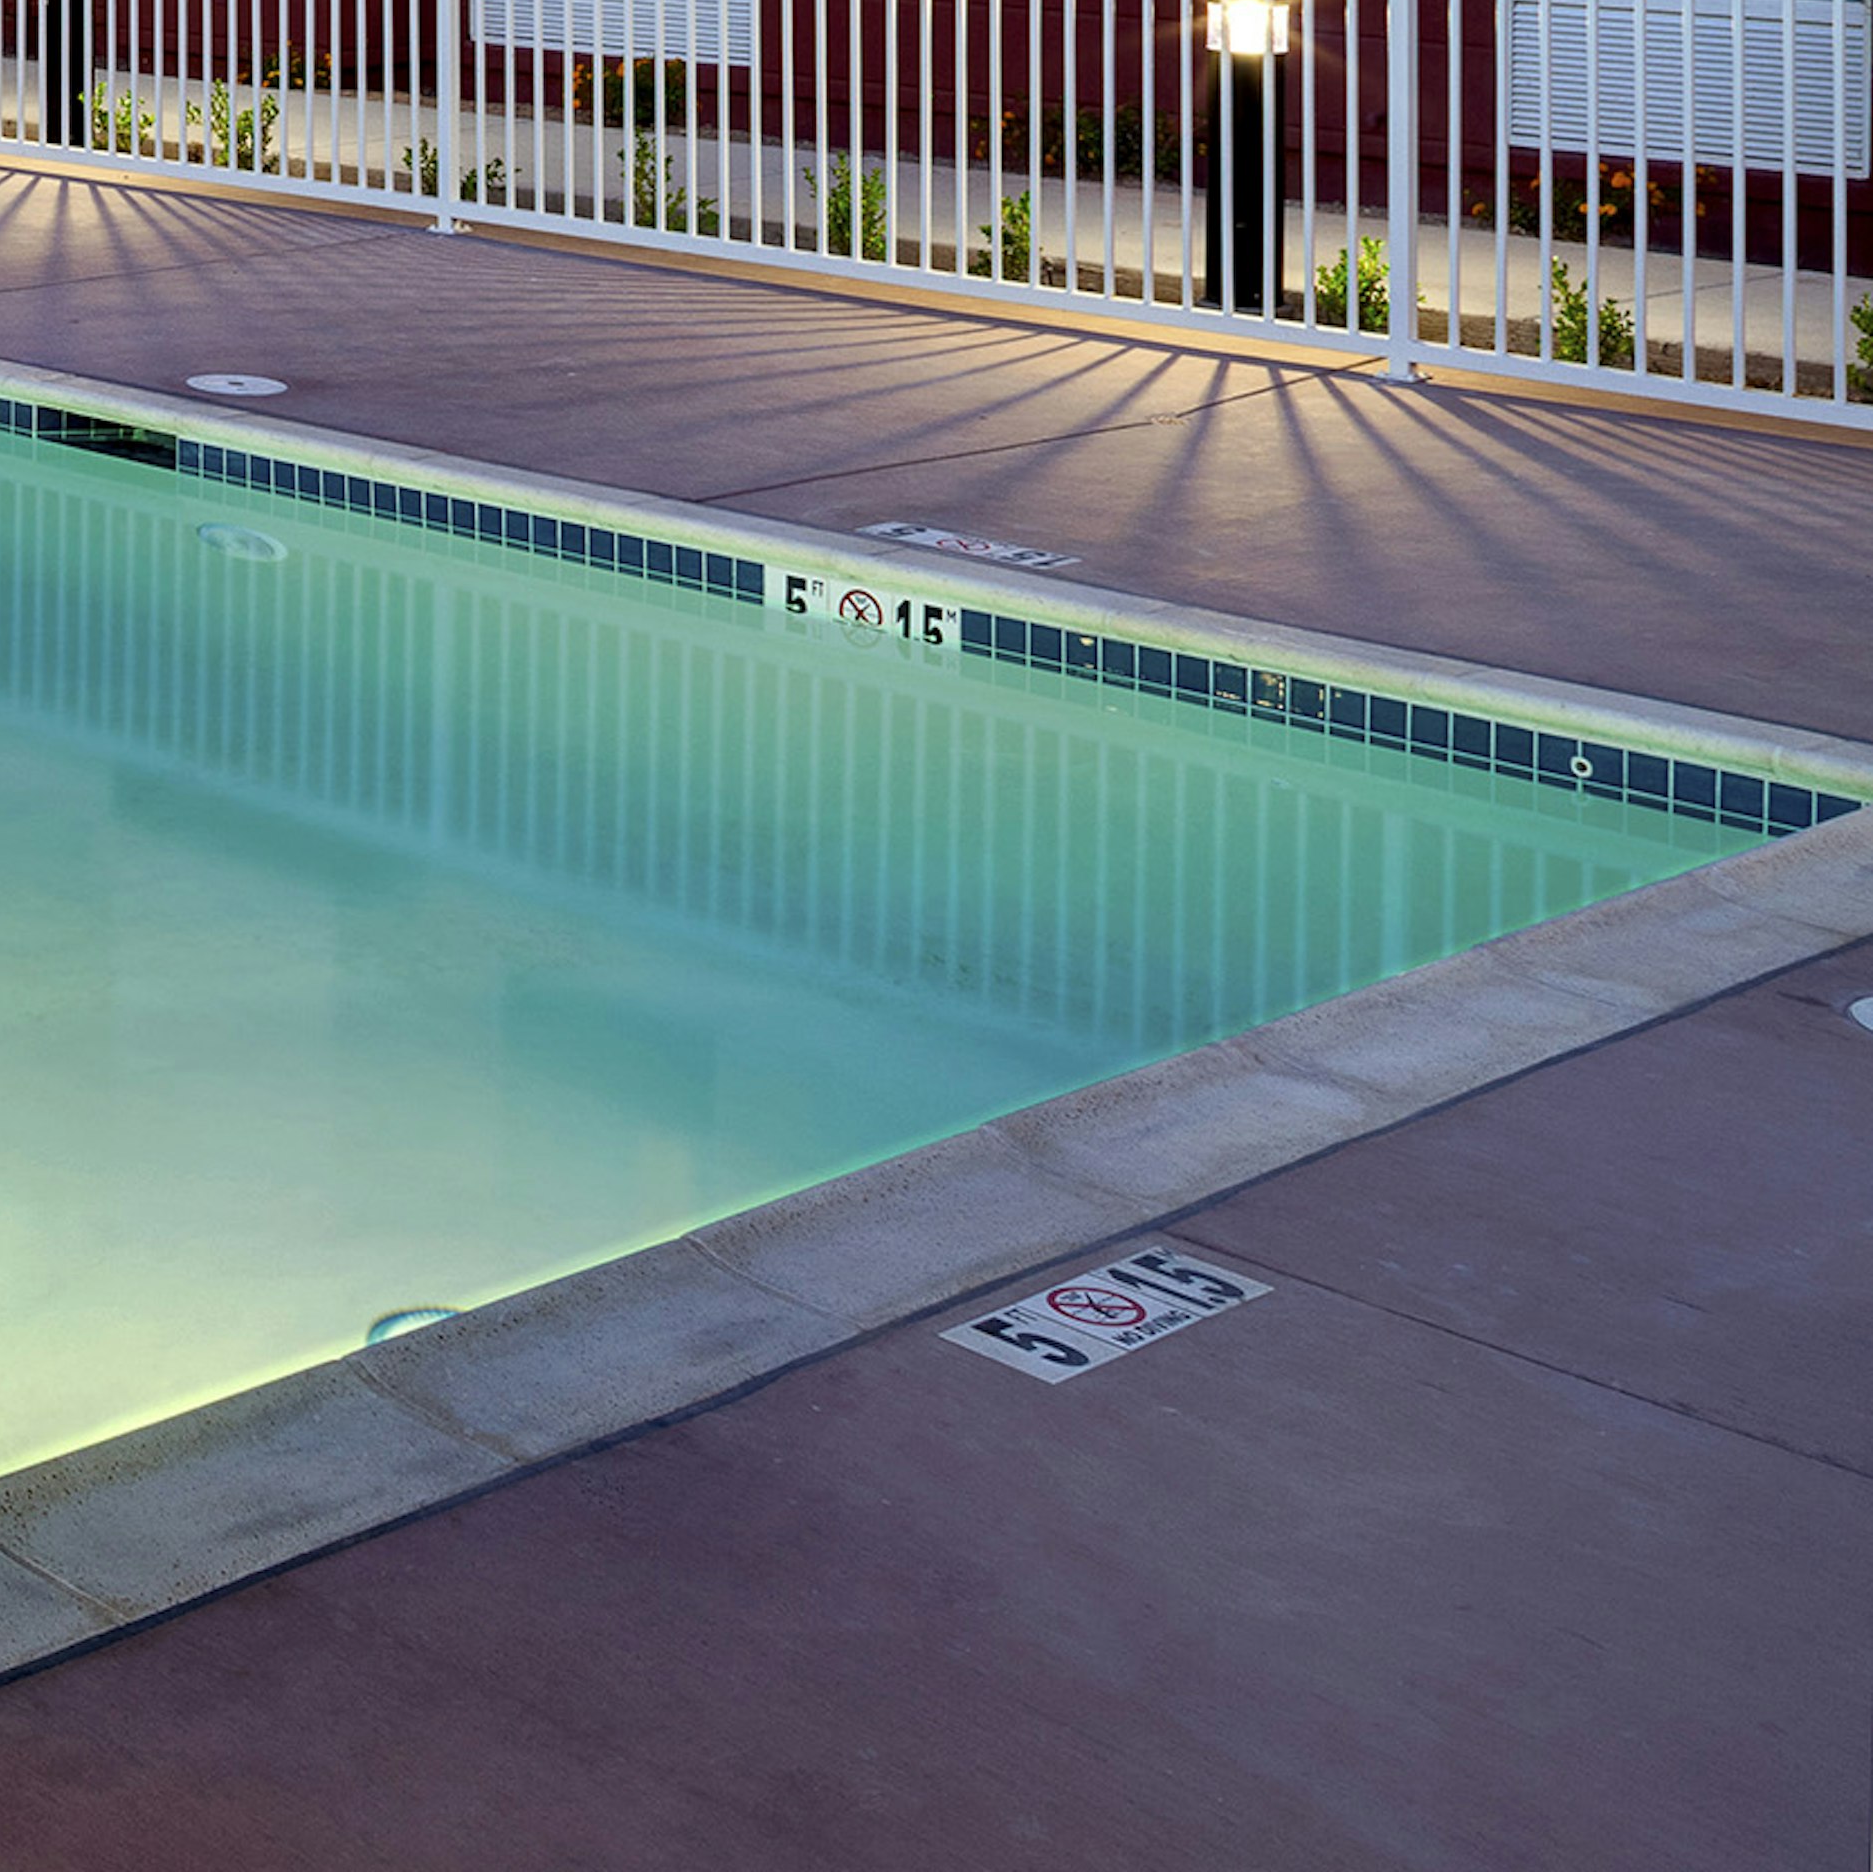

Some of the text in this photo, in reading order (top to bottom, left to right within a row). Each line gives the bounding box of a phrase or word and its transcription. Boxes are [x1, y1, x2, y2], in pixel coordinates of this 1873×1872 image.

[785, 574, 808, 615] 5
[970, 1316, 1090, 1367] 5
[1106, 1253, 1245, 1311] 1.5
